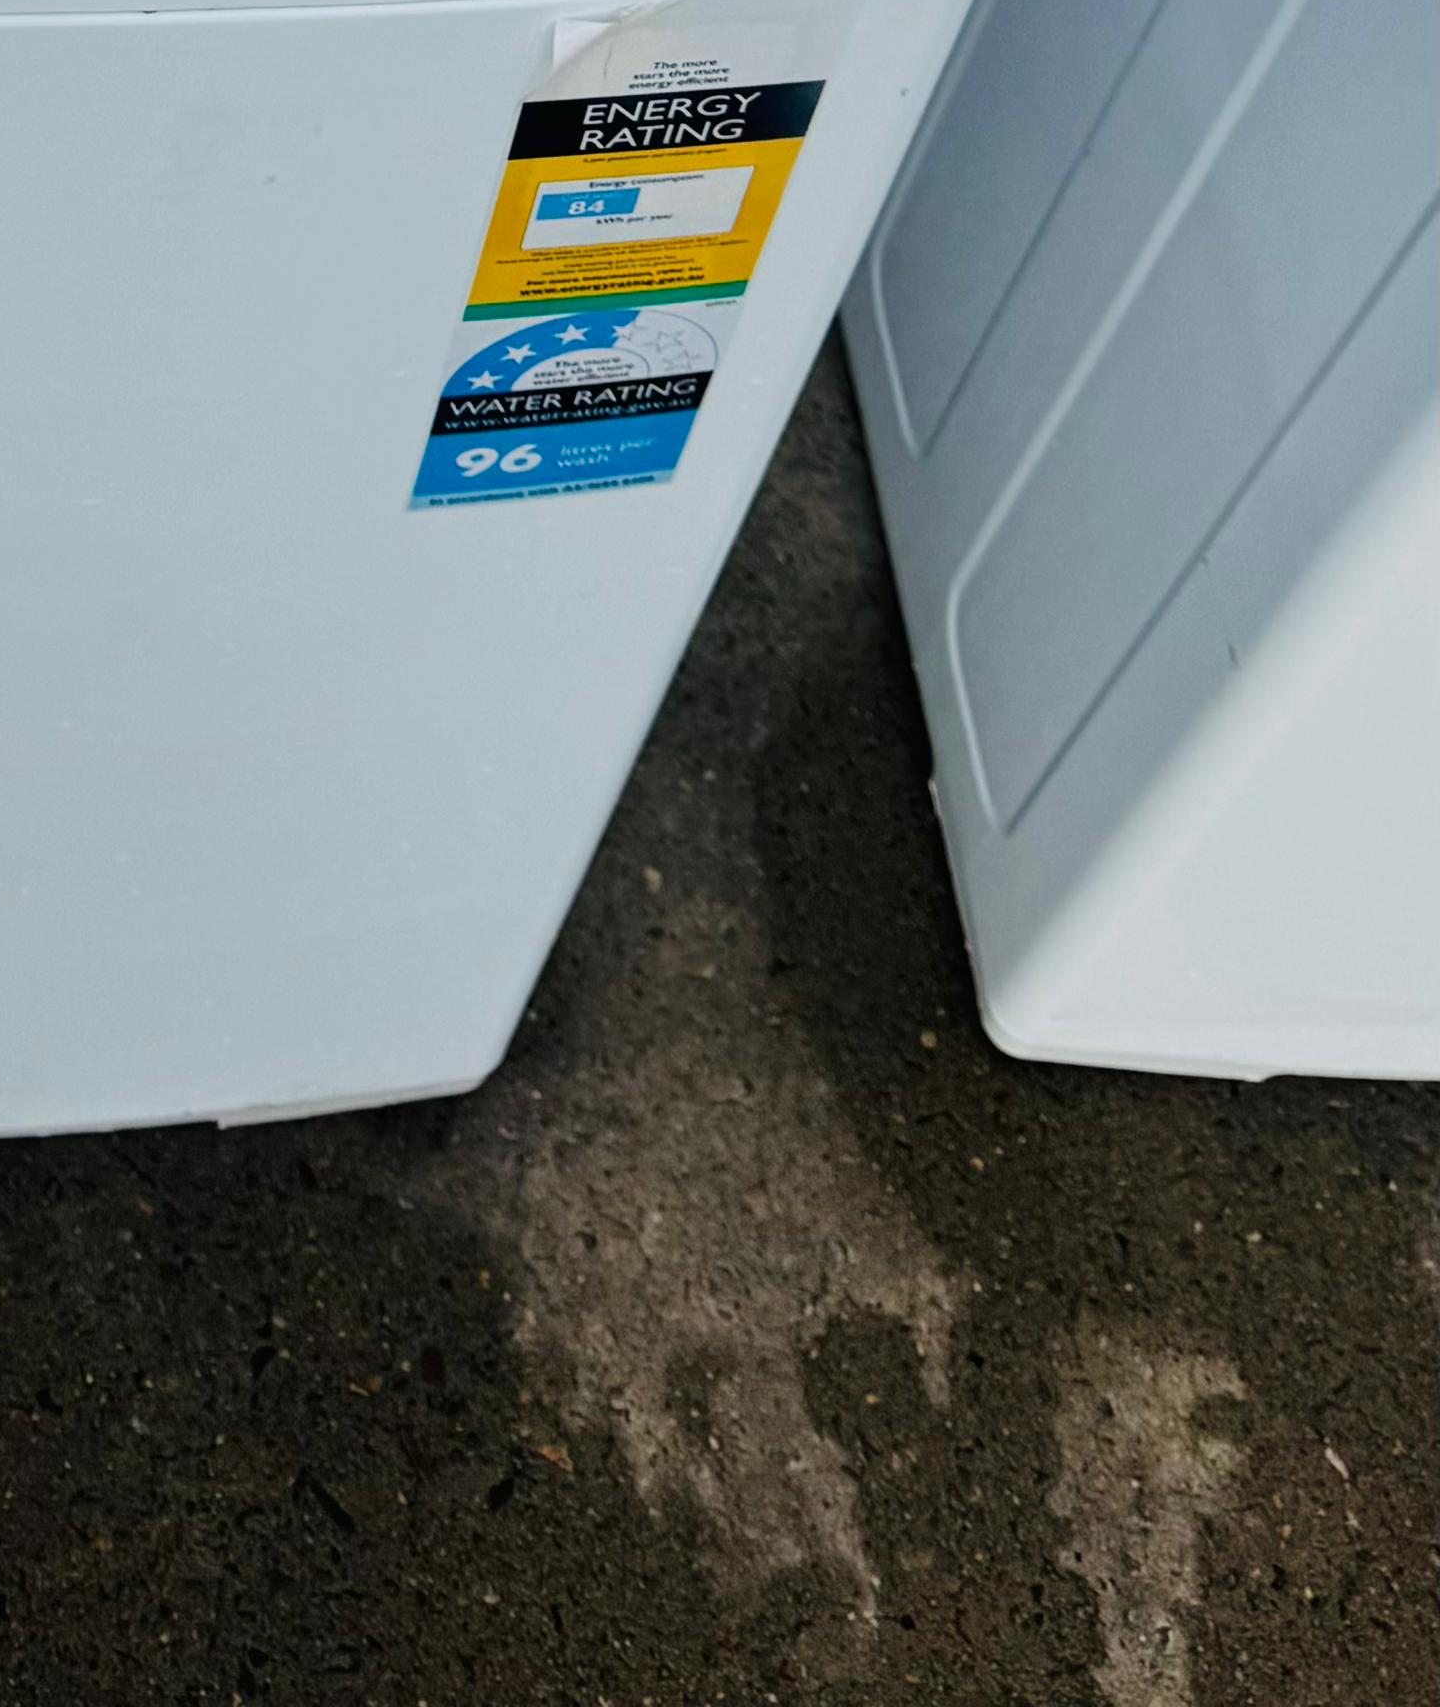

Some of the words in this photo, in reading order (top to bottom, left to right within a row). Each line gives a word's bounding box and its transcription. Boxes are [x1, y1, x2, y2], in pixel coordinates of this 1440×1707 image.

[654, 61, 678, 69] The
[681, 59, 718, 67] more
[633, 72, 665, 80] stars
[668, 69, 690, 78] the
[694, 67, 730, 76] more
[628, 81, 673, 89] energy
[676, 76, 728, 86] efficient
[582, 91, 761, 125] ENERGY
[579, 118, 746, 151] RATING
[589, 180, 629, 189] Energy
[567, 200, 605, 216] 84
[449, 393, 563, 416] WATER
[573, 378, 698, 406] RATING
[455, 444, 543, 478] 96
